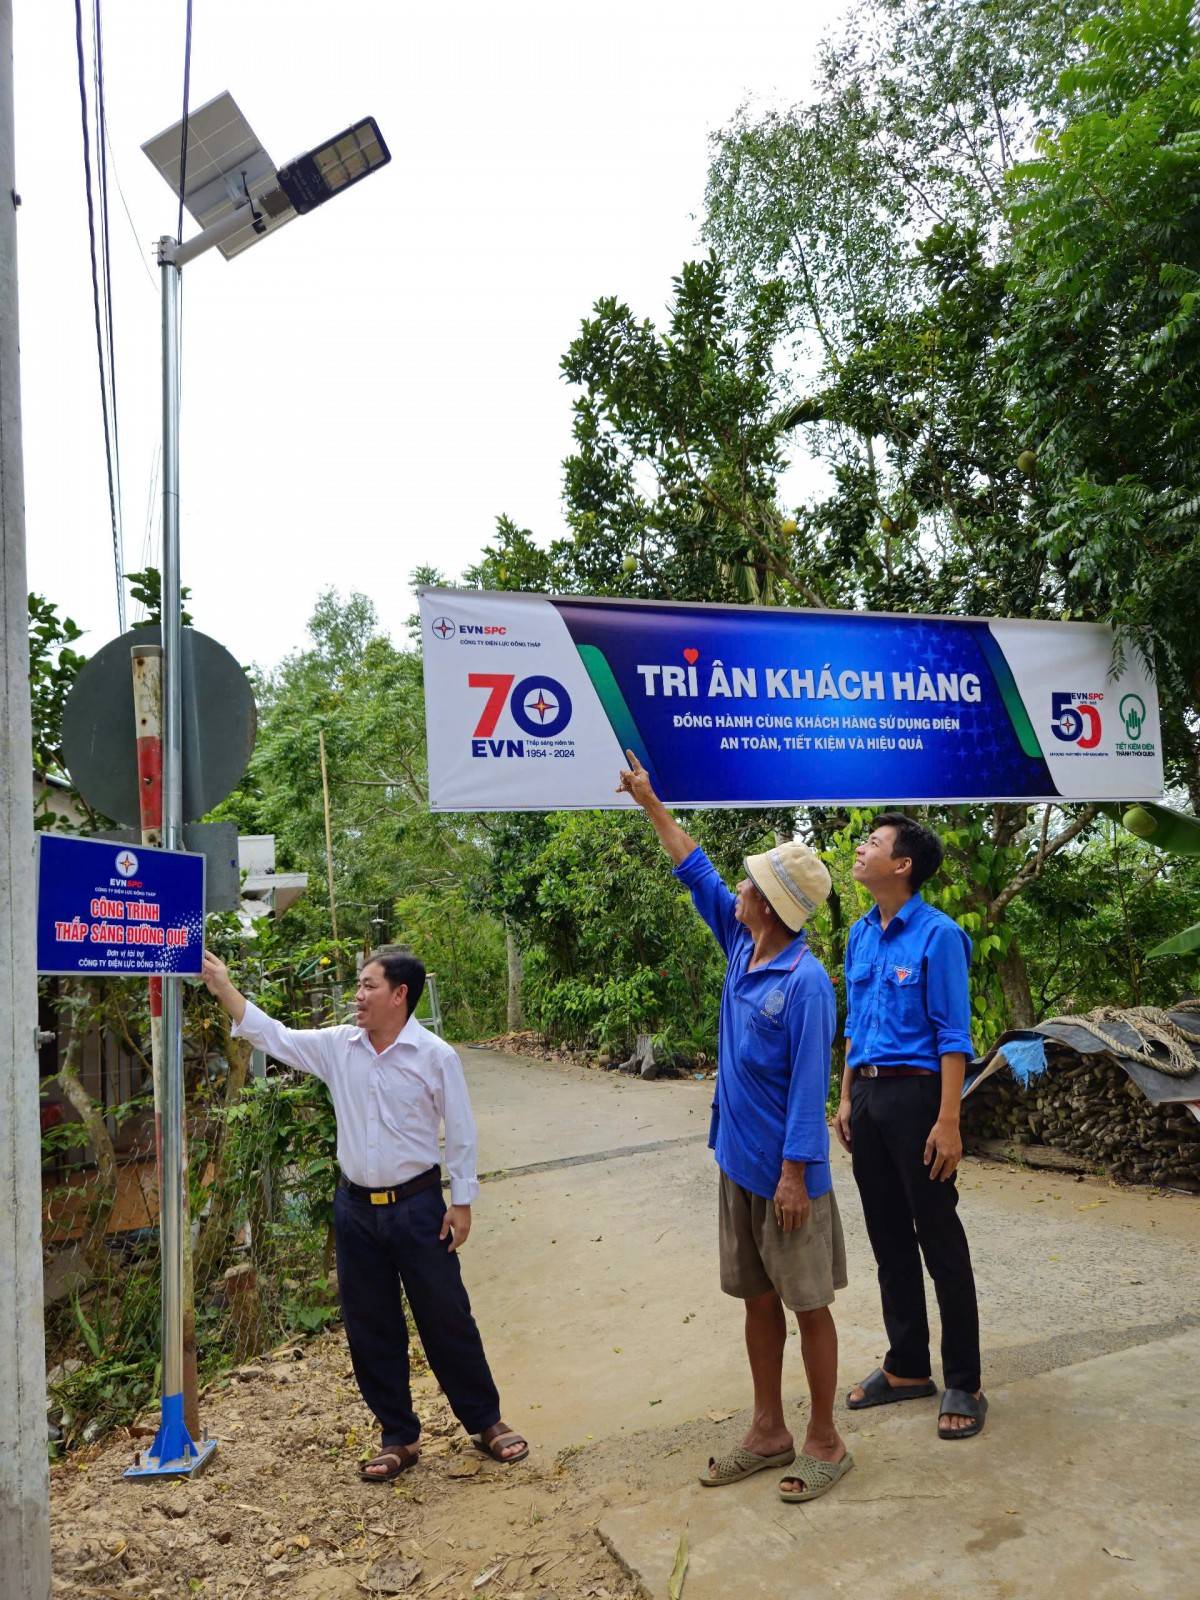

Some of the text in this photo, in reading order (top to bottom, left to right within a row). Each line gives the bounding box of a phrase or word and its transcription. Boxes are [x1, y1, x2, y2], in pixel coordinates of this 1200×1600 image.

[459, 625, 506, 635] EVNSPC
[707, 659, 758, 698] ÂN
[765, 663, 885, 700] KHÁCH
[892, 665, 982, 702] HÀNG
[1071, 692, 1104, 700] EVNSPC
[468, 672, 572, 738] 70
[715, 713, 753, 728] HÀNH
[755, 713, 793, 728] CÙNG
[795, 714, 840, 729] KHÁCH
[842, 715, 877, 729] HÀNG
[879, 714, 896, 729] SỬ
[897, 717, 931, 732] DỤNG
[932, 716, 960, 732] ĐIỆN
[1051, 692, 1102, 749] 50
[472, 740, 524, 757] EVN
[720, 734, 923, 751] AN TOÀN, TIẾT KIỆM VÀ HIỆU QUẢ
[526, 749, 546, 757] 1954
[554, 750, 575, 758] 2024
[110, 878, 143, 888] EVNSPC
[91, 896, 160, 921] CÔNG TRÌNH
[90, 921, 124, 944] SÁNG
[126, 923, 164, 946] ĐƯỜNG
[166, 926, 188, 947] QUÊ
[78, 957, 98, 966] CÔNG
[107, 958, 122, 968] ĐIỆN
[123, 959, 135, 968] LỰC
